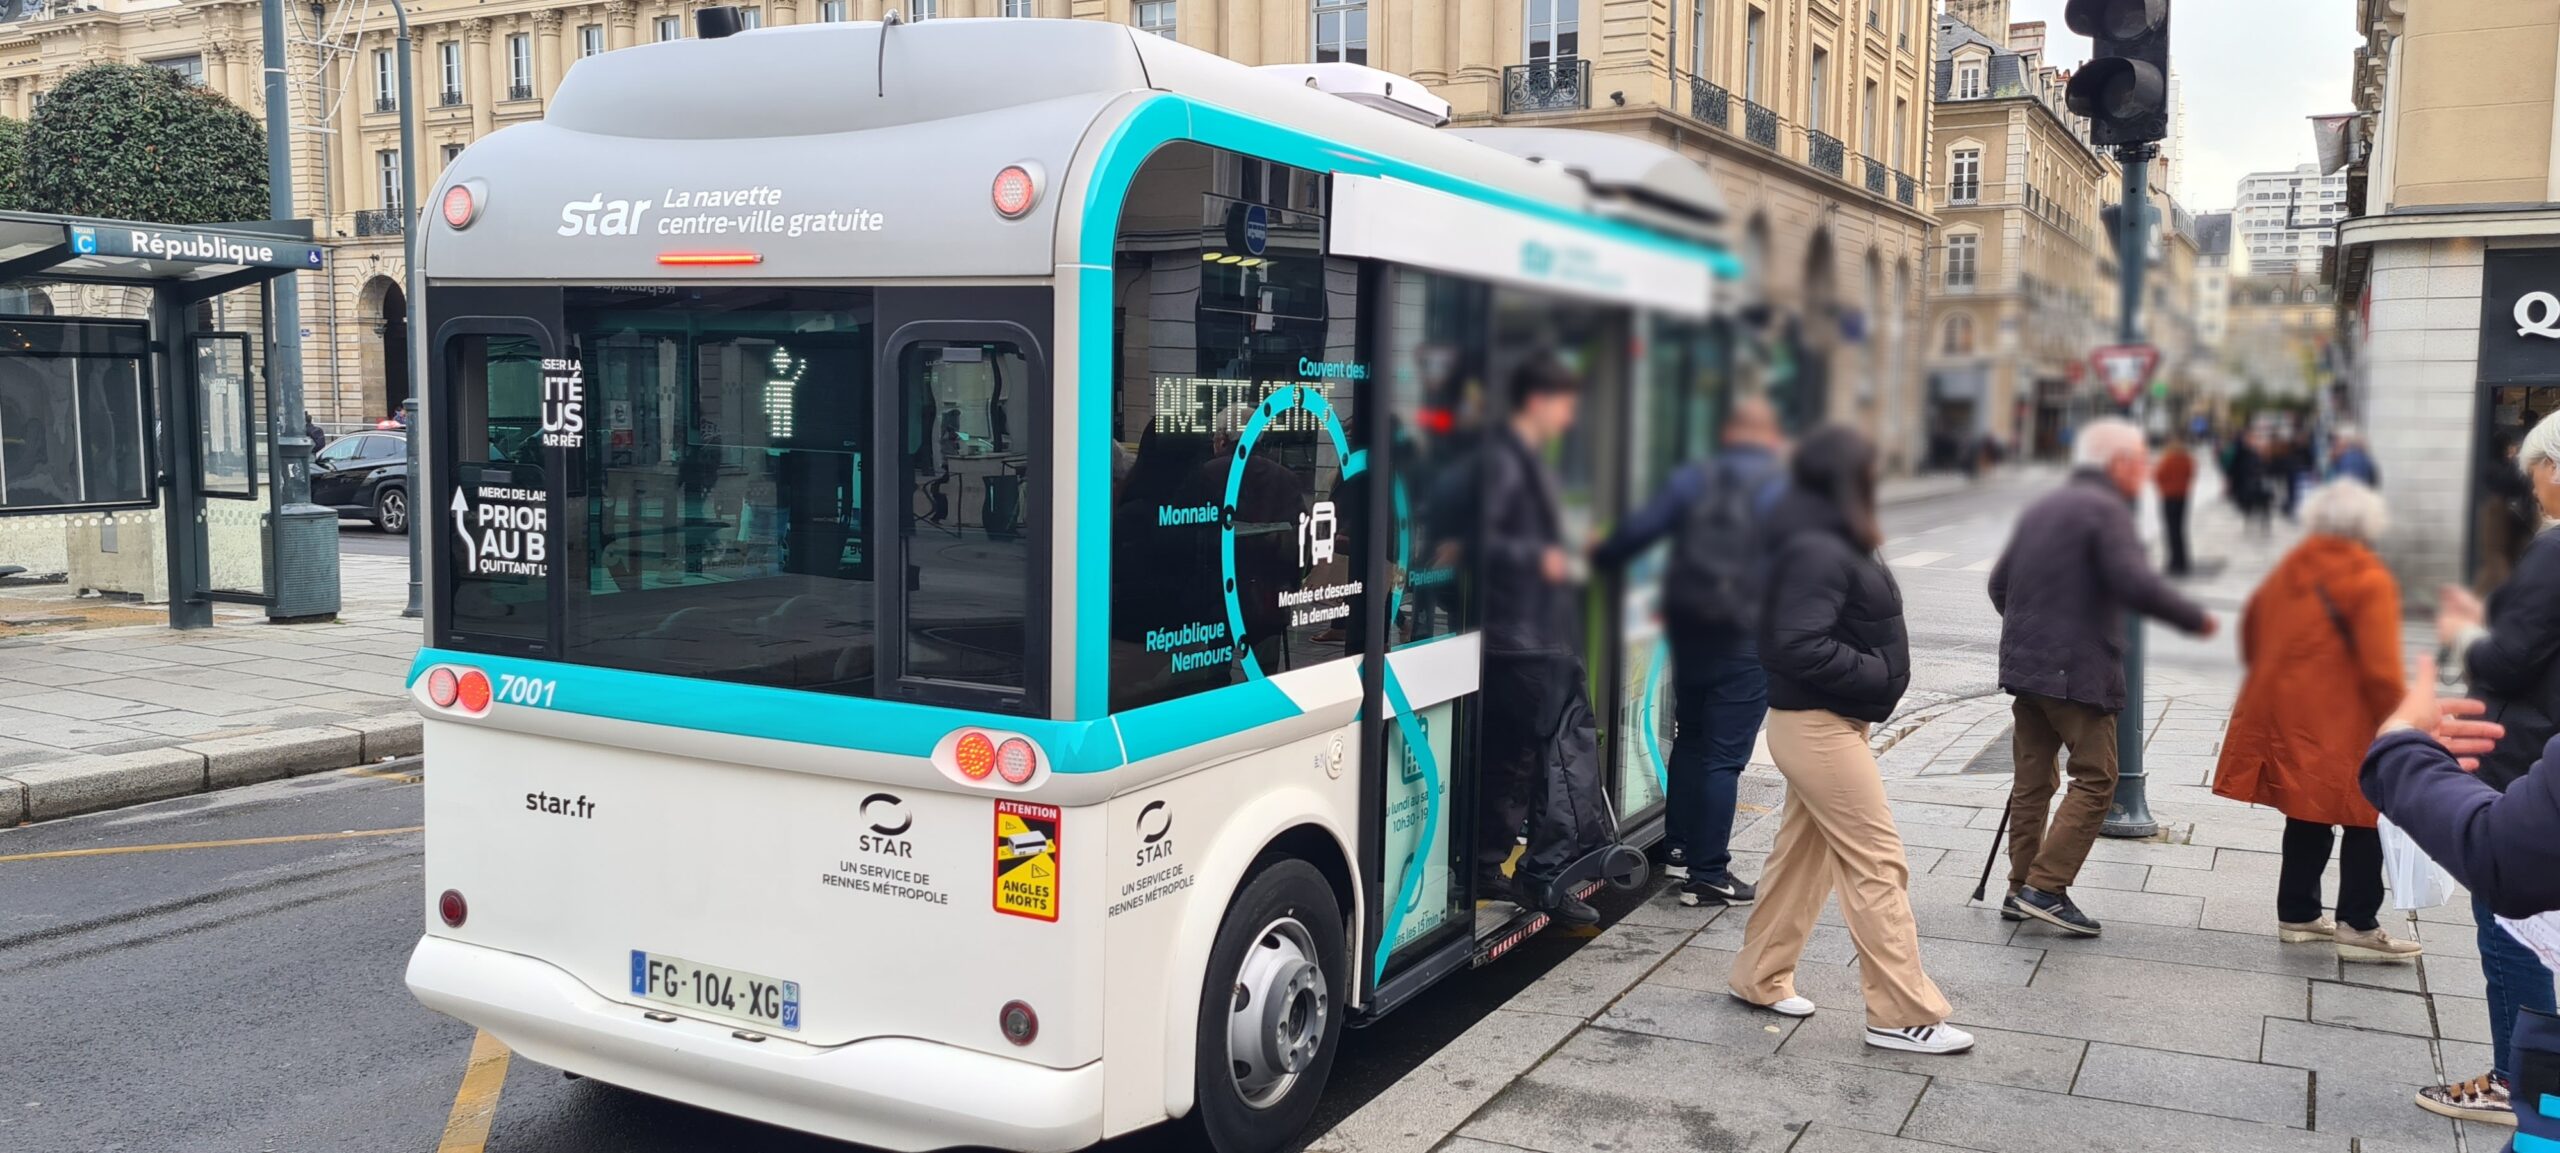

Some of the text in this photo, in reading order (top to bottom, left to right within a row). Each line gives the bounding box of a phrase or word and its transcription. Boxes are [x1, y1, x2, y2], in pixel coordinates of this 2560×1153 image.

[557, 185, 782, 237] star La navette
[657, 208, 884, 237] centre-ville gratuite
[78, 235, 93, 253] C
[131, 231, 273, 265] République
[568, 359, 582, 371] LA
[1298, 356, 1345, 378] Couvent
[1346, 360, 1365, 379] des
[542, 401, 583, 432] US
[543, 432, 583, 447] ARRÊT
[478, 487, 510, 499] MERCI
[511, 488, 526, 500] DE
[478, 503, 547, 531] PRIOR
[1158, 502, 1219, 526] Monnaie
[480, 528, 546, 561] AU B
[480, 558, 537, 575] QUITTANT
[1278, 580, 1363, 607] Montée et descente
[1291, 603, 1350, 627] à la demande
[1146, 621, 1225, 652] République
[1171, 644, 1233, 673] Nemours
[497, 674, 557, 707] 7001
[526, 790, 596, 820] star.fr
[998, 801, 1057, 819] ATTENTION
[1391, 796, 1410, 814] lundi
[1393, 812, 1416, 833] 10h30
[859, 834, 912, 859] STAR
[1136, 839, 1173, 867] STAR
[840, 860, 930, 885] UN SERVICE DE
[1121, 863, 1183, 896] UN SERVICE DE
[822, 873, 948, 905] RENNES MÉTROPOLE
[1003, 880, 1049, 898] ANGLES
[1005, 893, 1047, 910] MORTS
[1108, 874, 1195, 918] RENNES MÉTROPOLE
[635, 976, 642, 986] F
[649, 959, 780, 1019] FG-104-XG
[783, 1004, 797, 1021] 37
